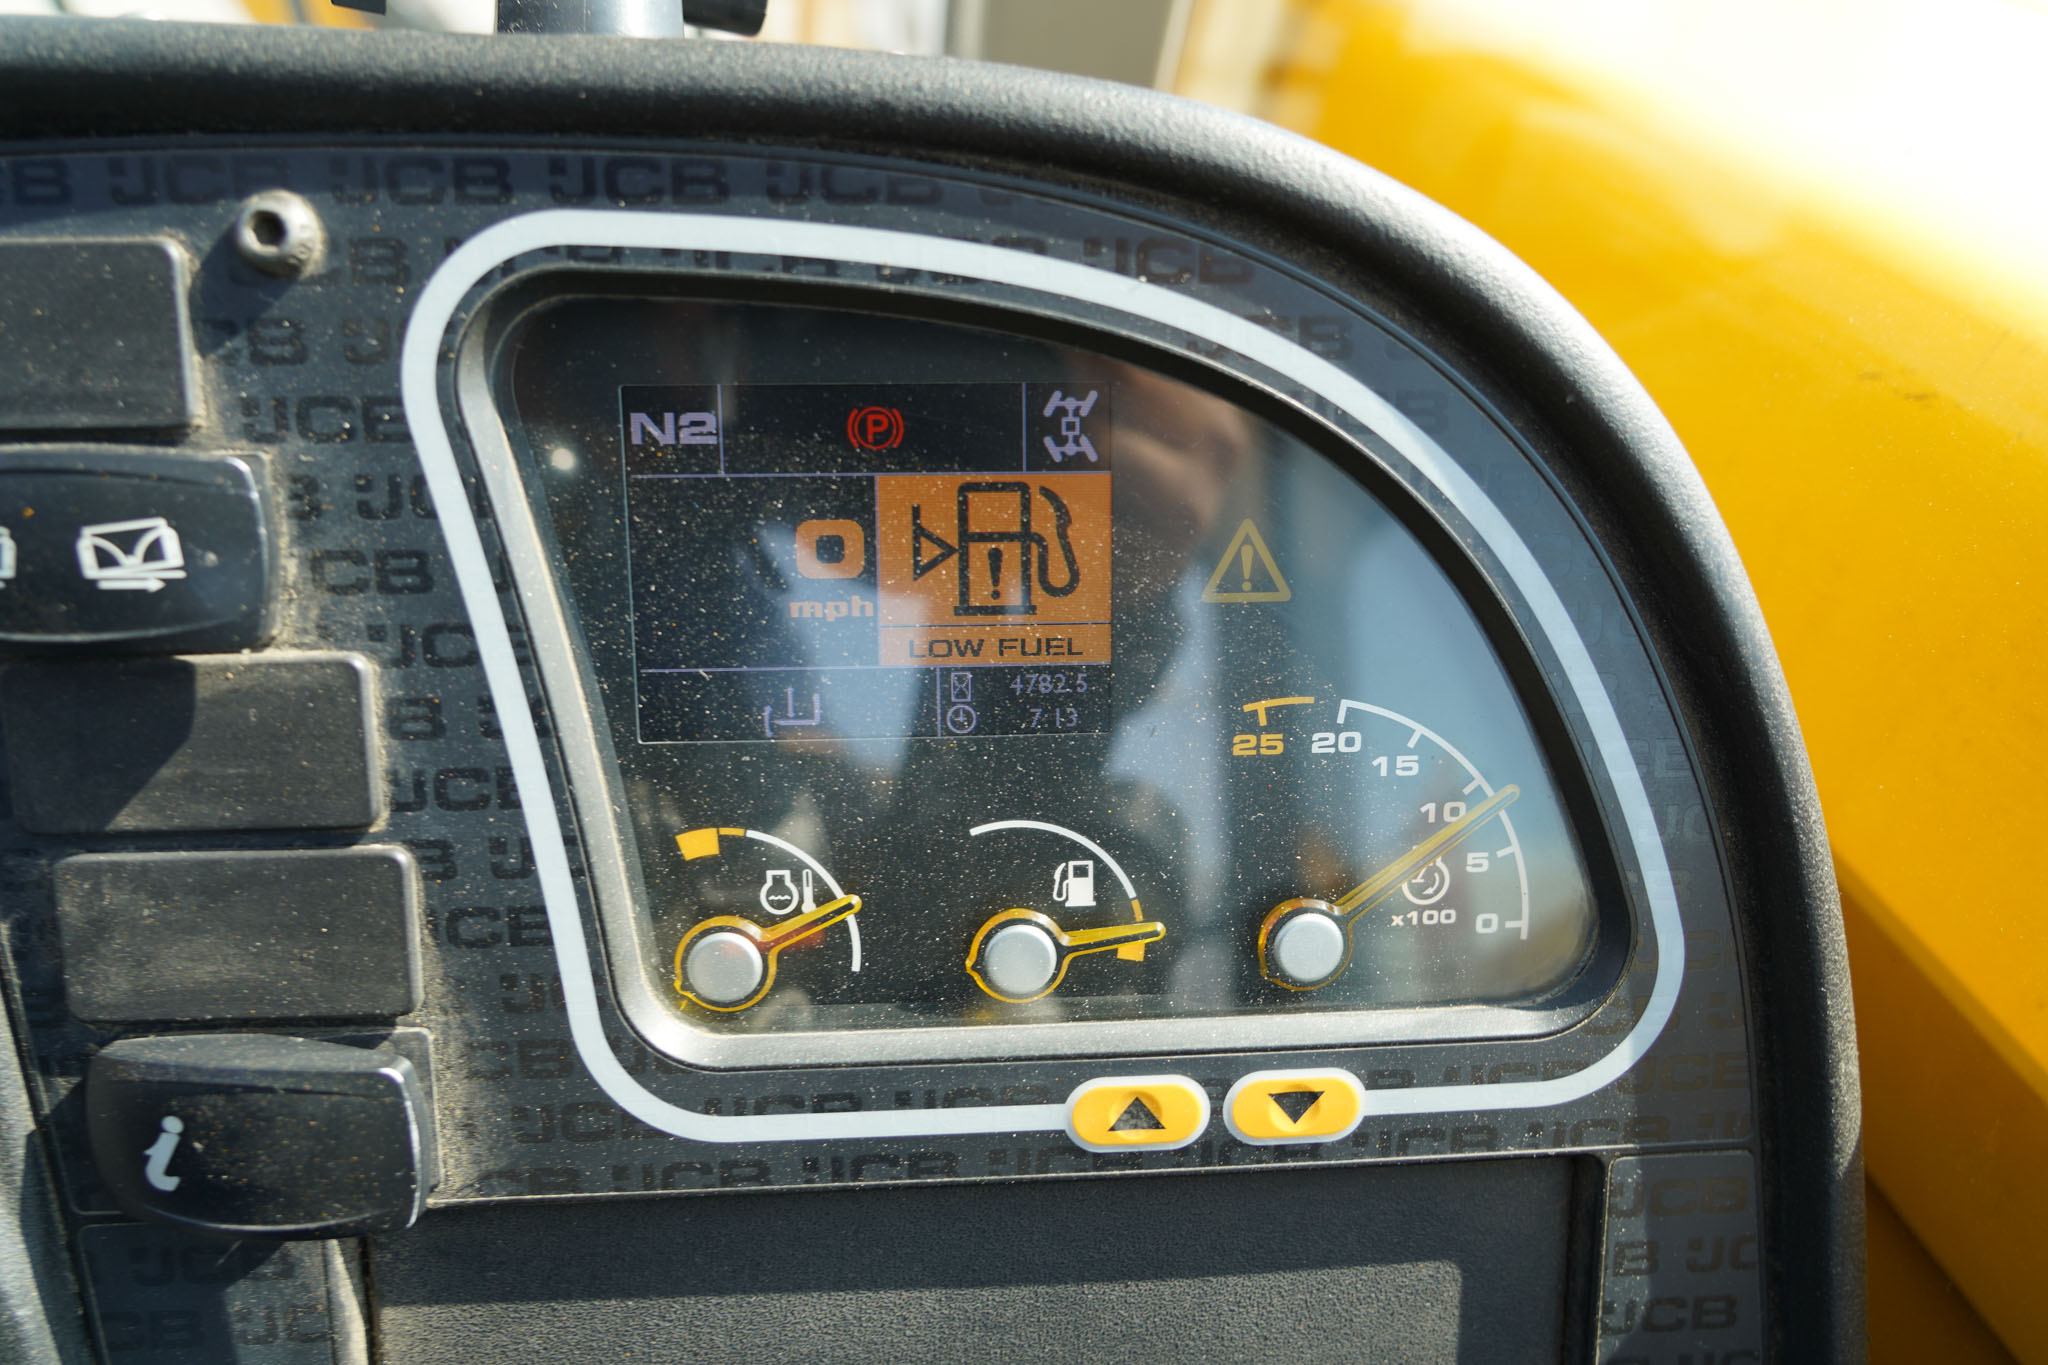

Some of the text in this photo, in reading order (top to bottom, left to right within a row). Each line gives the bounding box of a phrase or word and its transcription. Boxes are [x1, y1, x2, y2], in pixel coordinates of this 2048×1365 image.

[329, 154, 513, 205] JCB
[547, 155, 730, 204] JCB
[630, 411, 718, 445] N2
[310, 549, 435, 597] CB
[789, 595, 874, 622] mph
[908, 637, 1084, 659] LOW FUEL
[1232, 733, 1285, 756] 25
[1311, 731, 1362, 754] 20
[1371, 755, 1420, 777] 15
[1419, 801, 1467, 823] 10
[1465, 852, 1490, 873] 5
[1390, 909, 1457, 926] x100
[1475, 913, 1499, 934] 0
[1608, 1176, 1749, 1217] JCB
[1600, 1294, 1738, 1335] JCB
